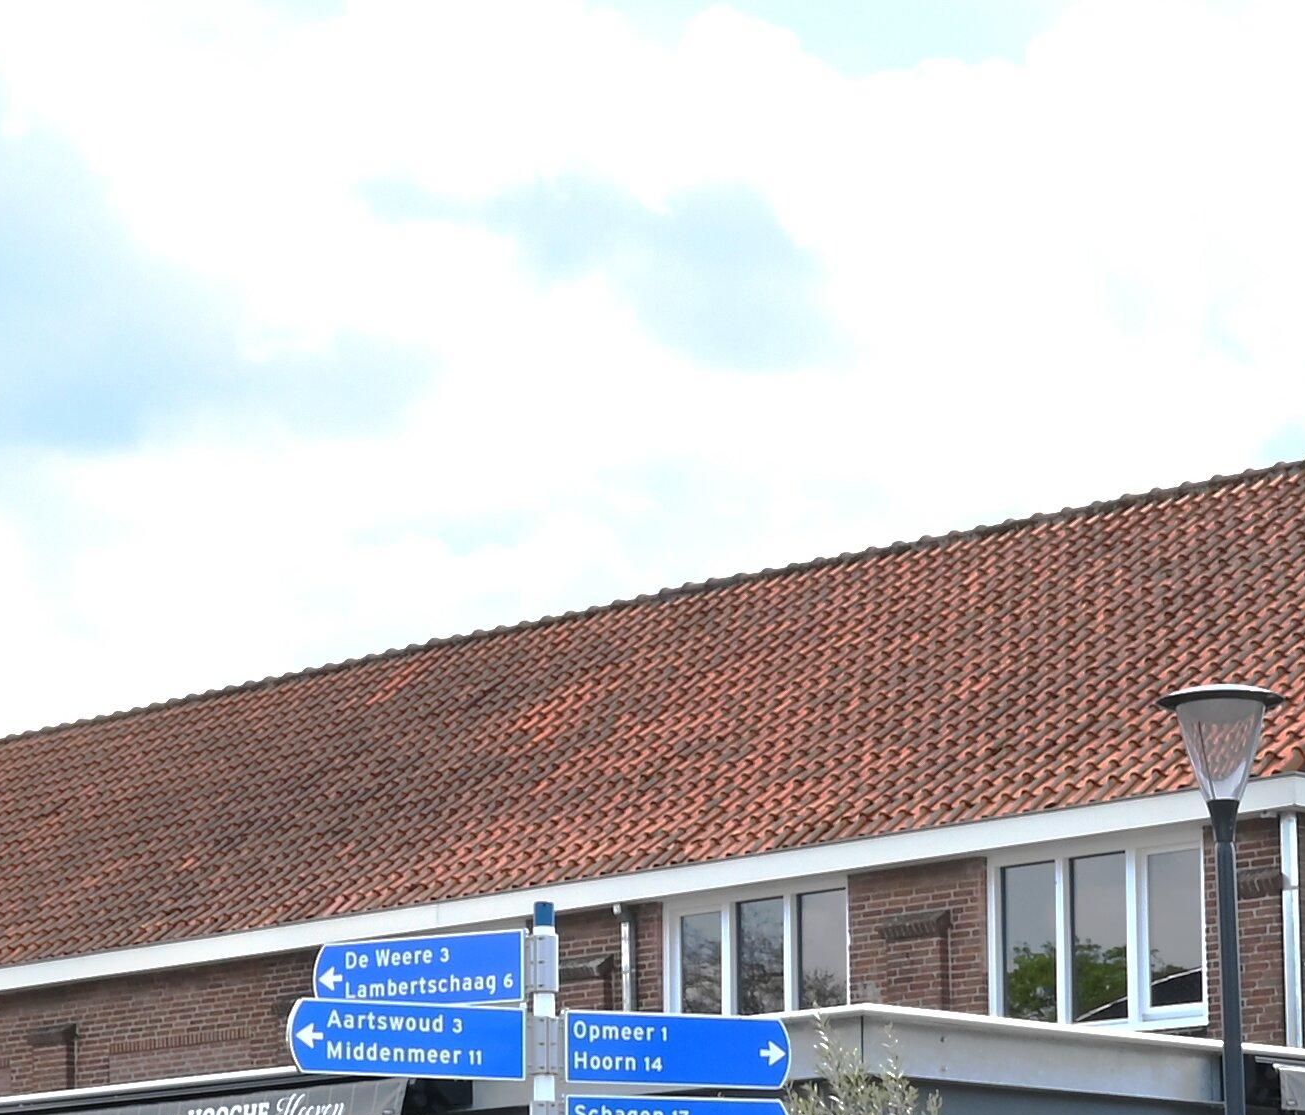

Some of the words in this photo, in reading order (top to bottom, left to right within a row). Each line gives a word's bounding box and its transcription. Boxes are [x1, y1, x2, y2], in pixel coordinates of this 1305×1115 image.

[345, 951, 369, 969] De
[376, 948, 433, 967] Weere
[440, 948, 450, 963] 3
[345, 974, 496, 999] Lambertschaag
[503, 973, 514, 988] 6
[327, 1009, 444, 1033] Aartswoud
[452, 1018, 463, 1034] 3
[573, 1020, 655, 1042] Opmeer
[661, 1026, 668, 1041] 1
[327, 1041, 462, 1064] Middenmeer
[469, 1050, 482, 1065] 11
[574, 1051, 636, 1071] Hoorn
[644, 1057, 663, 1072] 14
